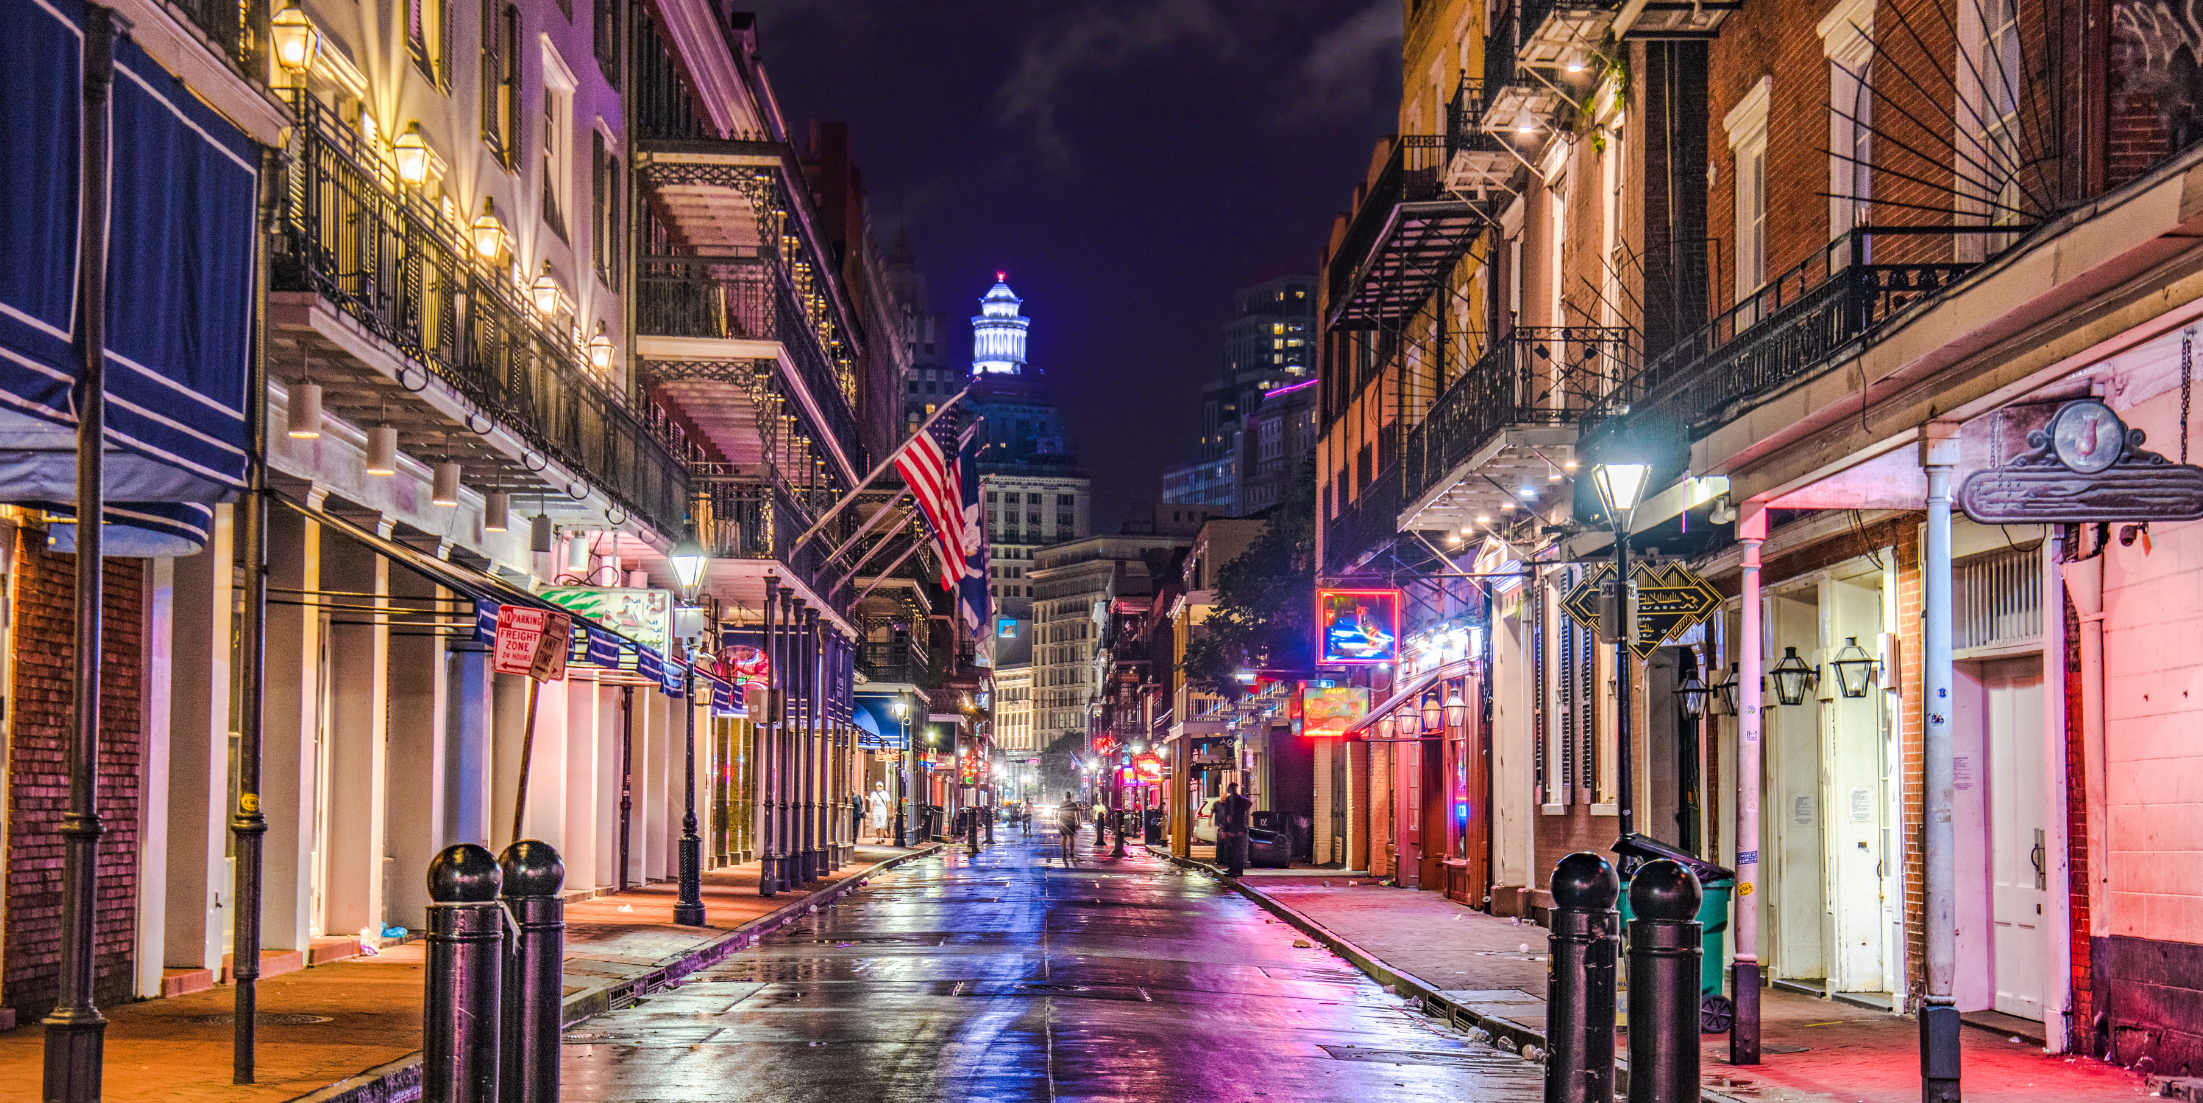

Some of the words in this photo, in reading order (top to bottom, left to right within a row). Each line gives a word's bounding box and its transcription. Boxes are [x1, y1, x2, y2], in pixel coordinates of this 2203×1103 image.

[499, 611, 512, 624] NO
[512, 613, 542, 626] PARKING
[500, 629, 538, 642] FREIGHT
[505, 640, 530, 652] ZONE
[543, 637, 558, 652] ANY
[512, 652, 532, 662] HOURS
[537, 650, 553, 667] TIME
